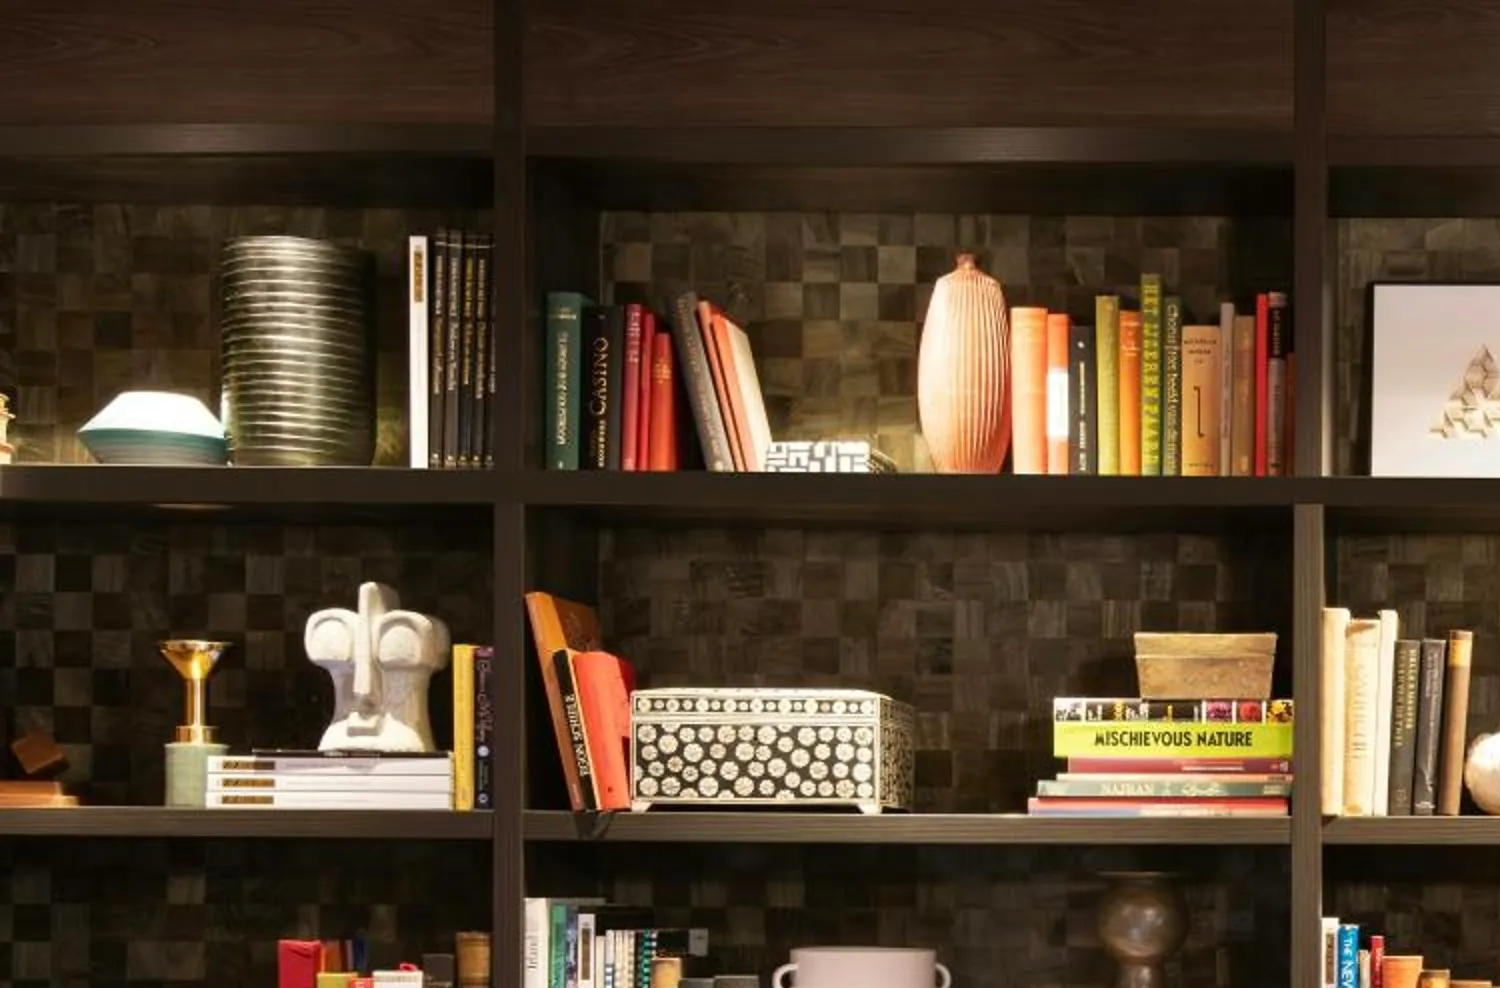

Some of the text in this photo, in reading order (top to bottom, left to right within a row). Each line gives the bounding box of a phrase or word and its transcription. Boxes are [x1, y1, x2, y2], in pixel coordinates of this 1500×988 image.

[589, 336, 608, 416] CASINO
[564, 693, 591, 777] EGON SCHIELE
[1094, 731, 1253, 747] MISCHIEVOUS NATURE
[1342, 938, 1352, 957] THE
